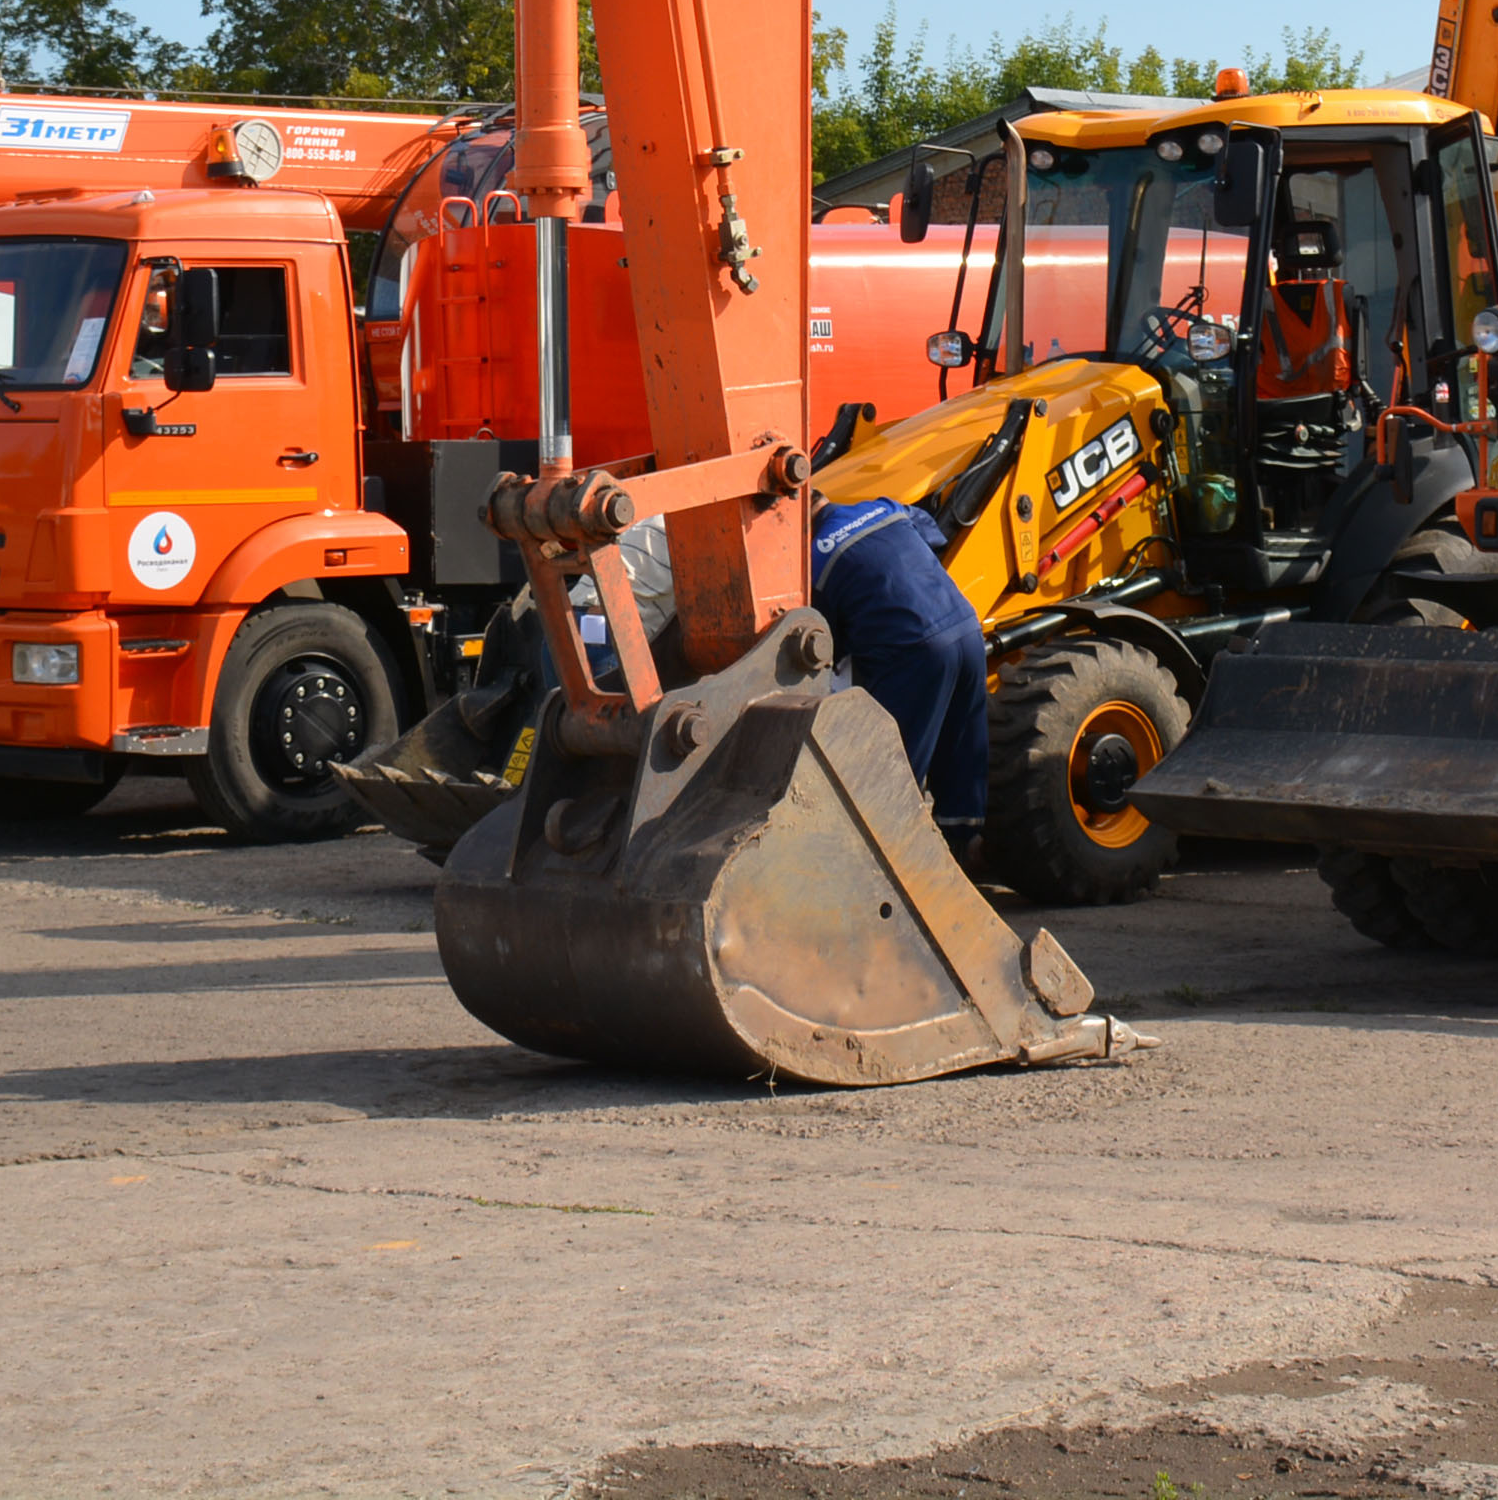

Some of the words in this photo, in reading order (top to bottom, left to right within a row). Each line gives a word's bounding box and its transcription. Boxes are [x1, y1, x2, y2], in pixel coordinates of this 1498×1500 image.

[286, 125, 346, 137] ГОРЯЧАЯ
[294, 136, 339, 147] ЛИНИЯ
[282, 147, 357, 162] -800-555-86-98
[809, 321, 831, 337] АШ
[157, 426, 195, 435] 43253
[1053, 419, 1139, 508] JCB
